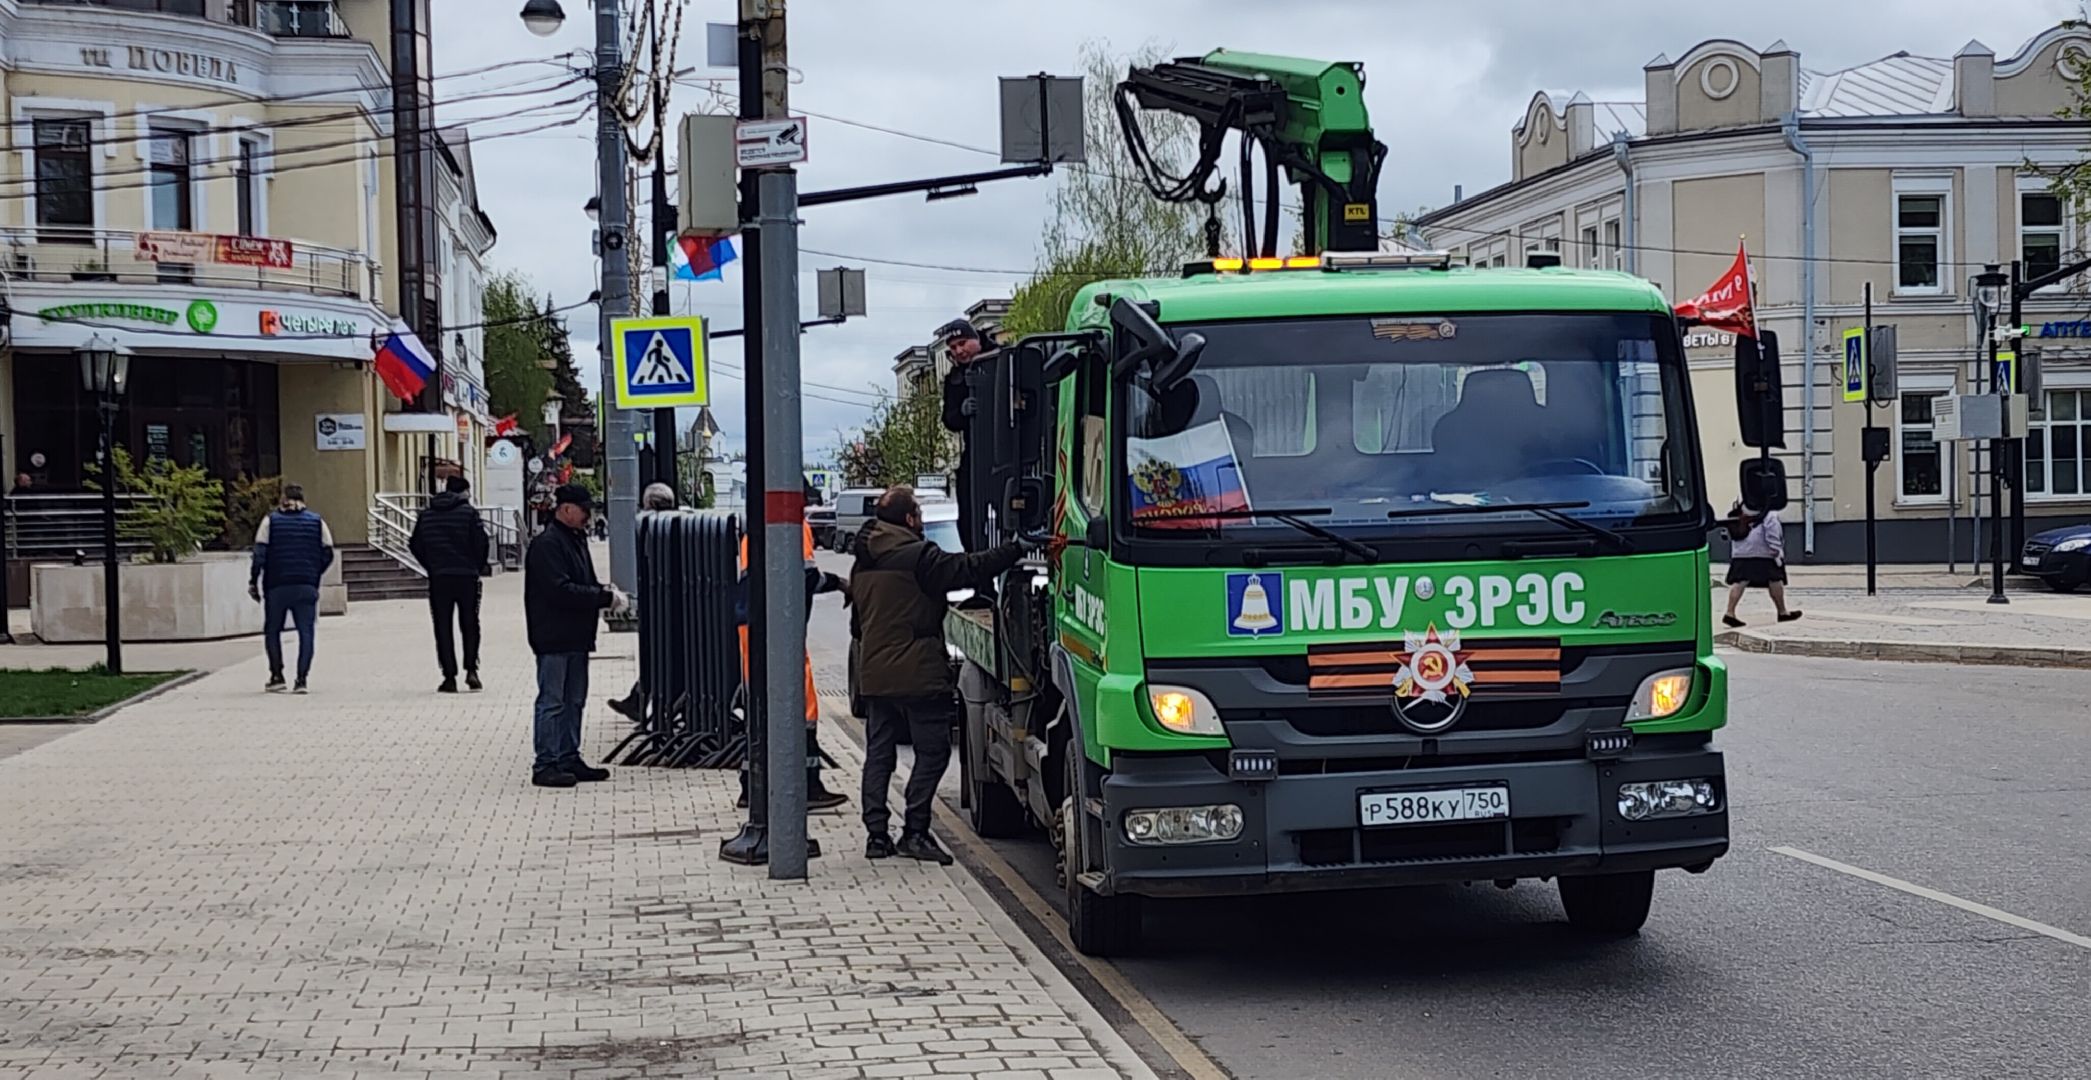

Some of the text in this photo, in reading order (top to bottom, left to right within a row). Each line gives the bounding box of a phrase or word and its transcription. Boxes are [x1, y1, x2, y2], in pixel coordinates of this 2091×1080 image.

[128, 45, 238, 84] ПОБЕДА
[2040, 321, 2091, 337] АПТЕ
[1683, 333, 1719, 347] ВЕТЫ
[1289, 572, 1585, 631] МБУ ЗРЭС
[1465, 791, 1501, 811] 750
